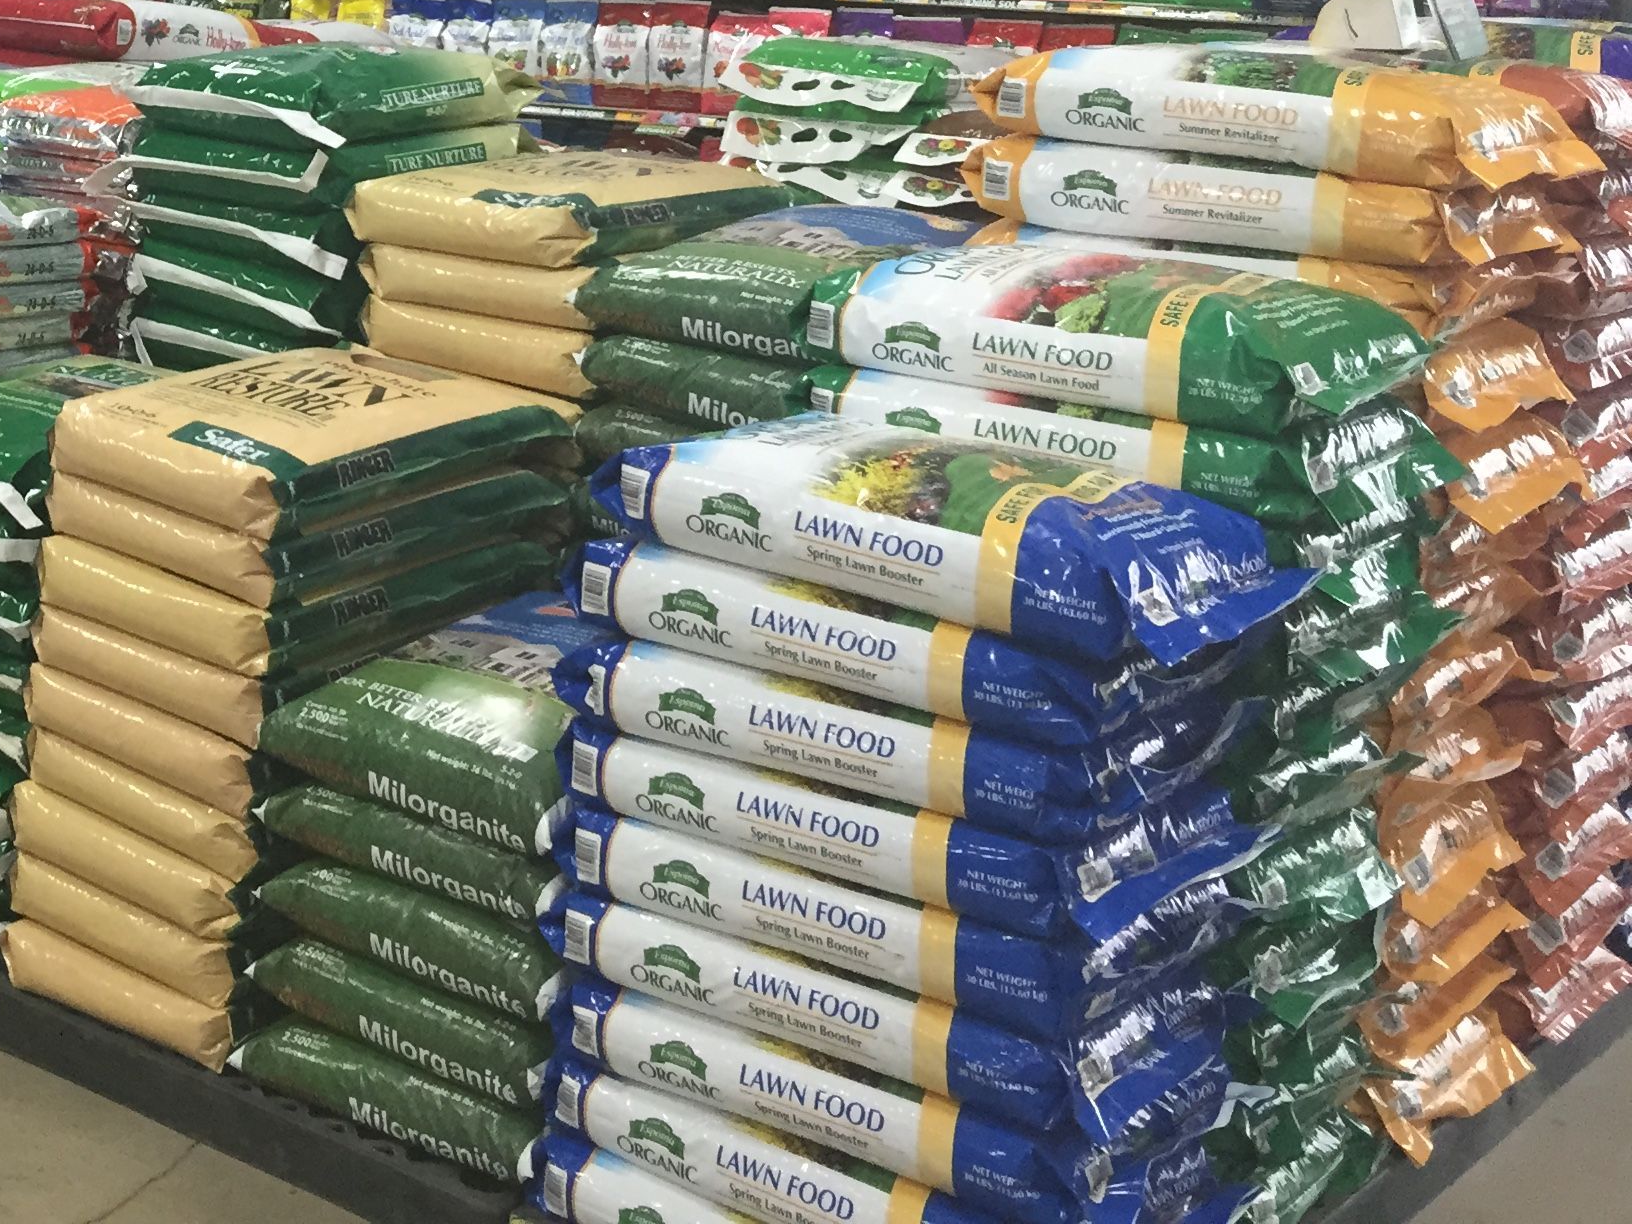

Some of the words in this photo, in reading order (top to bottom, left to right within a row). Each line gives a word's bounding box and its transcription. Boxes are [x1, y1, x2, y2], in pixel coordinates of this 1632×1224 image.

[1065, 108, 1146, 133] ORGANIC
[1163, 95, 1226, 120] LAWN
[1232, 103, 1299, 127] FOOD
[1179, 122, 1215, 138] Summer
[1217, 126, 1280, 144] Revitalizer
[389, 154, 423, 173] TURF
[425, 145, 485, 169] NURTURE
[1050, 190, 1130, 215] ORGANIC
[1147, 177, 1208, 200] LAWN
[1214, 183, 1283, 207] FOOD
[1163, 203, 1199, 220] Summer
[1201, 207, 1263, 224] Revitalizer
[871, 342, 956, 373] ORGANIC
[972, 332, 1039, 361] LAWN
[1044, 343, 1113, 372] FOOD
[190, 370, 351, 419] RESTORE
[239, 361, 412, 407] LAWN
[983, 363, 997, 376] All
[1000, 365, 1037, 381] Season
[1040, 372, 1068, 385] Lawn
[1071, 377, 1100, 392] Food
[194, 427, 270, 462] Safer
[973, 417, 1042, 447] LAWN
[1047, 432, 1117, 462] FOOD
[685, 514, 774, 553] ORGANIC
[794, 510, 863, 548] LAWN
[869, 531, 944, 567] FOOD
[807, 545, 843, 569] Spring
[845, 554, 876, 574] Lawn
[879, 564, 925, 586] Booster
[648, 610, 734, 649] ORGANIC
[750, 606, 819, 644] LAWN
[824, 627, 897, 663] FOOD
[764, 641, 799, 663] Spring
[802, 650, 832, 670] Lawn
[834, 659, 878, 681] Booster
[368, 681, 423, 704] BETTER
[645, 710, 731, 749] ORGANIC
[748, 704, 818, 741] LAWN
[823, 723, 896, 759] FOOD
[763, 739, 799, 761] Spring
[801, 748, 831, 768] Lawn
[833, 757, 878, 779] Booster
[368, 769, 527, 855] Milorganite
[635, 794, 721, 834] ORGANIC
[736, 791, 804, 829] LAWN
[809, 811, 880, 848] FOOD
[750, 826, 786, 850] Spring
[788, 837, 818, 857] Lawn
[819, 845, 863, 868] Booster
[370, 845, 530, 921] Milorganite
[639, 881, 726, 922] ORGANIC
[741, 879, 810, 918] LAWN
[815, 900, 886, 941] FOOD
[755, 915, 792, 940] Spring
[793, 926, 824, 947] Lawn
[826, 936, 870, 961] Booster
[369, 931, 526, 1020] Milorganite
[629, 963, 717, 1007] ORGANIC
[733, 966, 802, 1006] LAWN
[807, 990, 880, 1030] FOOD
[747, 1001, 785, 1025] Spring
[786, 1011, 817, 1033] Lawn
[819, 1023, 864, 1049] Booster
[358, 1014, 518, 1106] Milorganite
[637, 1060, 722, 1102] ORGANIC
[738, 1063, 807, 1107] LAWN
[813, 1089, 885, 1133] FOOD
[348, 1095, 509, 1182] Milorganite
[754, 1100, 790, 1125] Spring
[792, 1112, 824, 1134] Lawn
[825, 1125, 870, 1150] Booster
[616, 1134, 699, 1185] ORGANIC
[716, 1145, 782, 1191] LAWN
[786, 1175, 855, 1221] FOOD
[728, 1182, 763, 1209] Spring
[764, 1196, 794, 1222] Lawn
